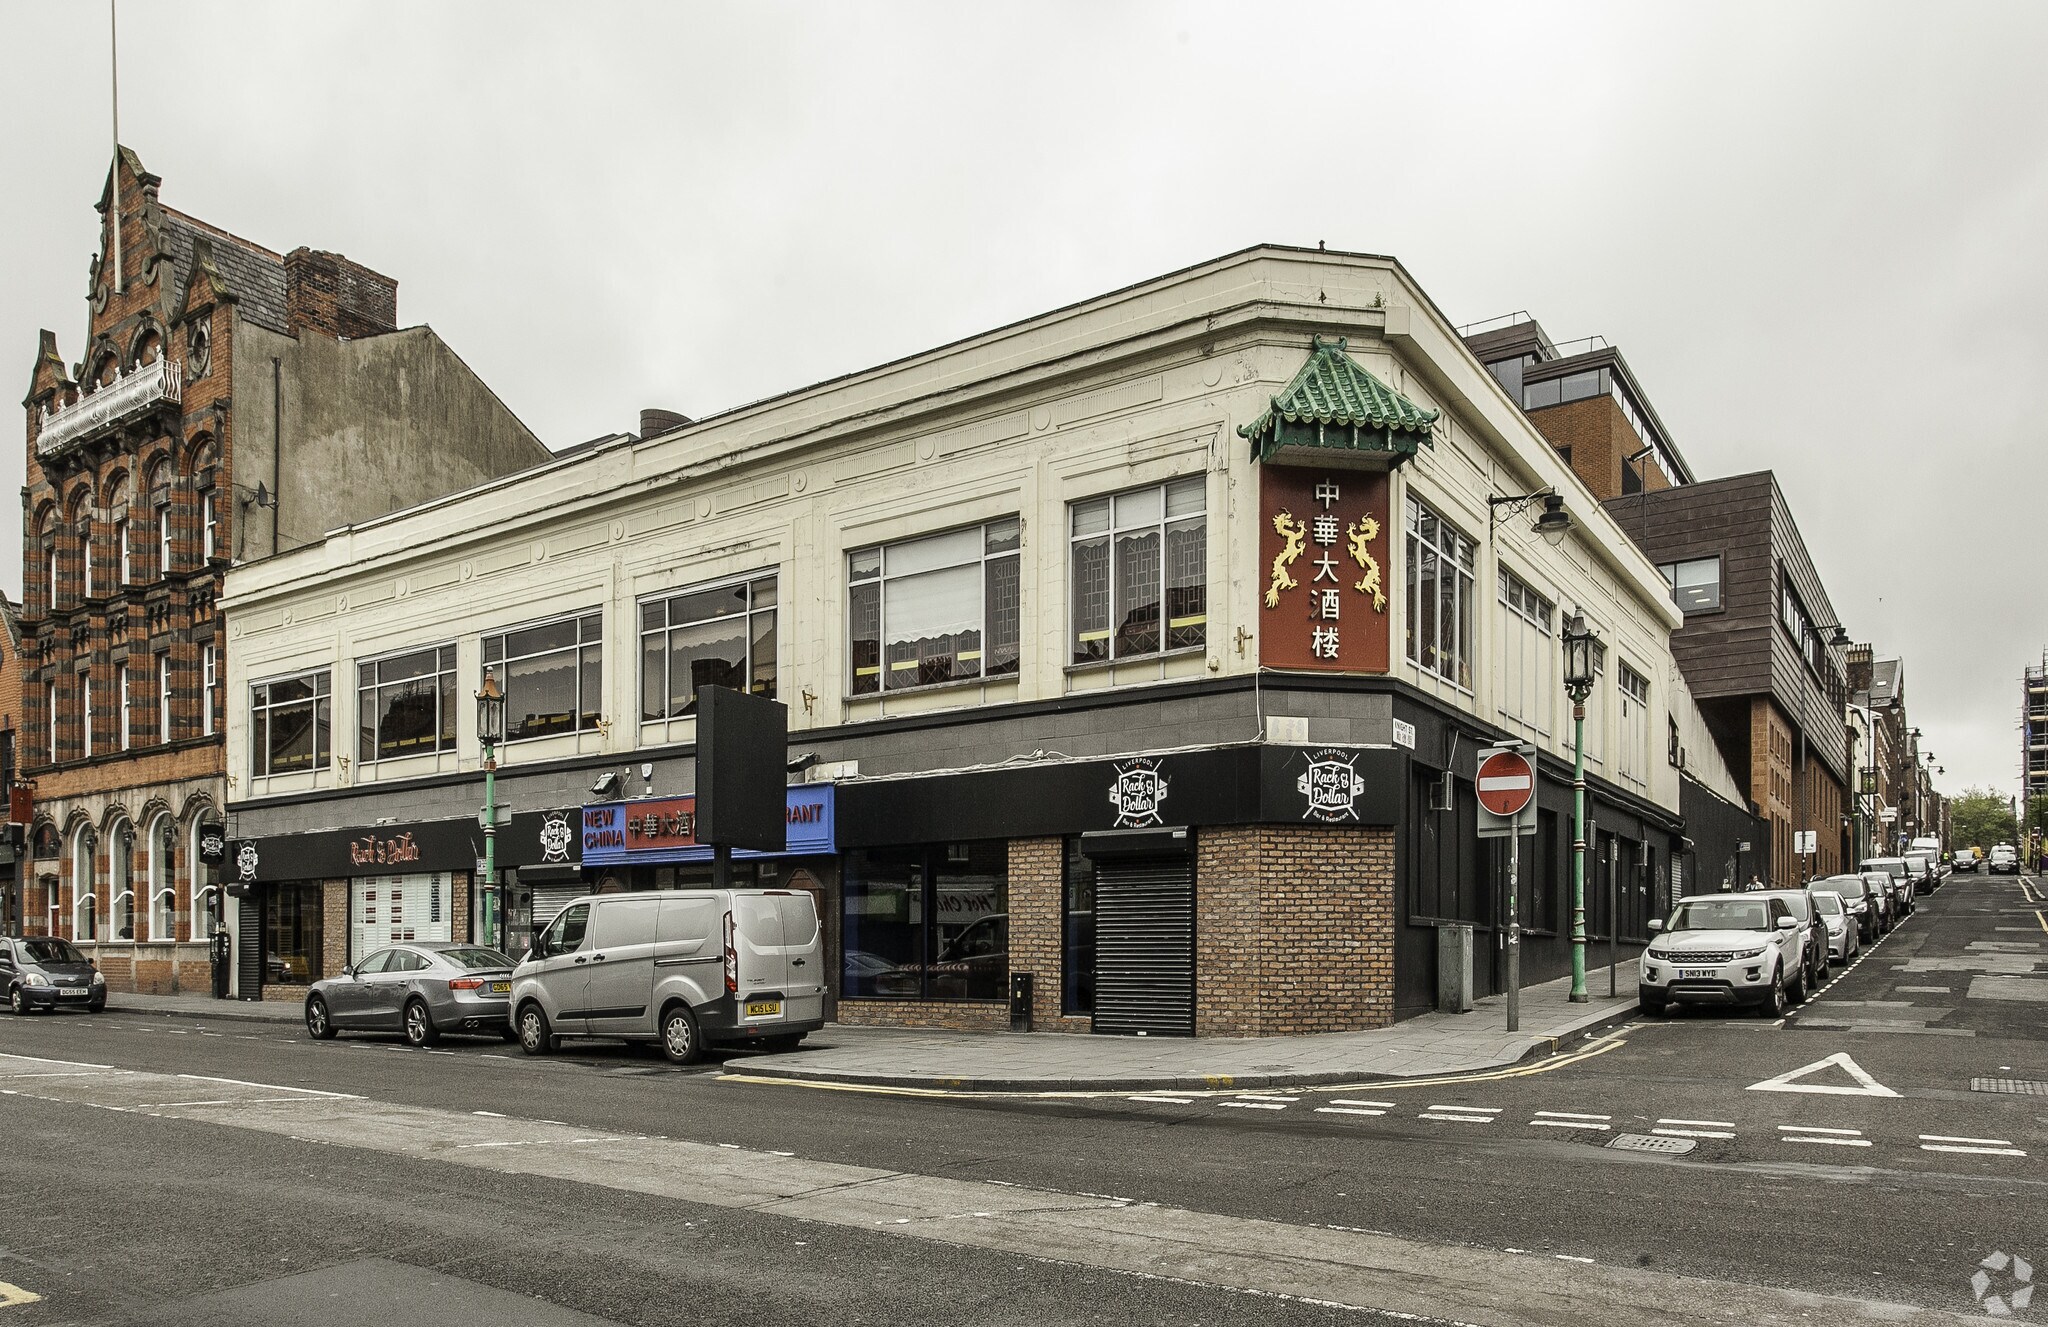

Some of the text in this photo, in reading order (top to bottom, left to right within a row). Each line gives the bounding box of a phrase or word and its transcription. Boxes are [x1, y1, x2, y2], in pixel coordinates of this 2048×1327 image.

[1122, 758, 1153, 770] LIVERPOOL
[1313, 749, 1348, 760] LIVERPOOL
[1122, 774, 1154, 795] Rack &
[1313, 766, 1349, 788] Rack &
[1122, 791, 1154, 812] Dollar
[1313, 784, 1349, 804] Dollar
[584, 809, 615, 828] NEW
[628, 809, 695, 840] 中華大酒
[584, 829, 624, 849] CHINA
